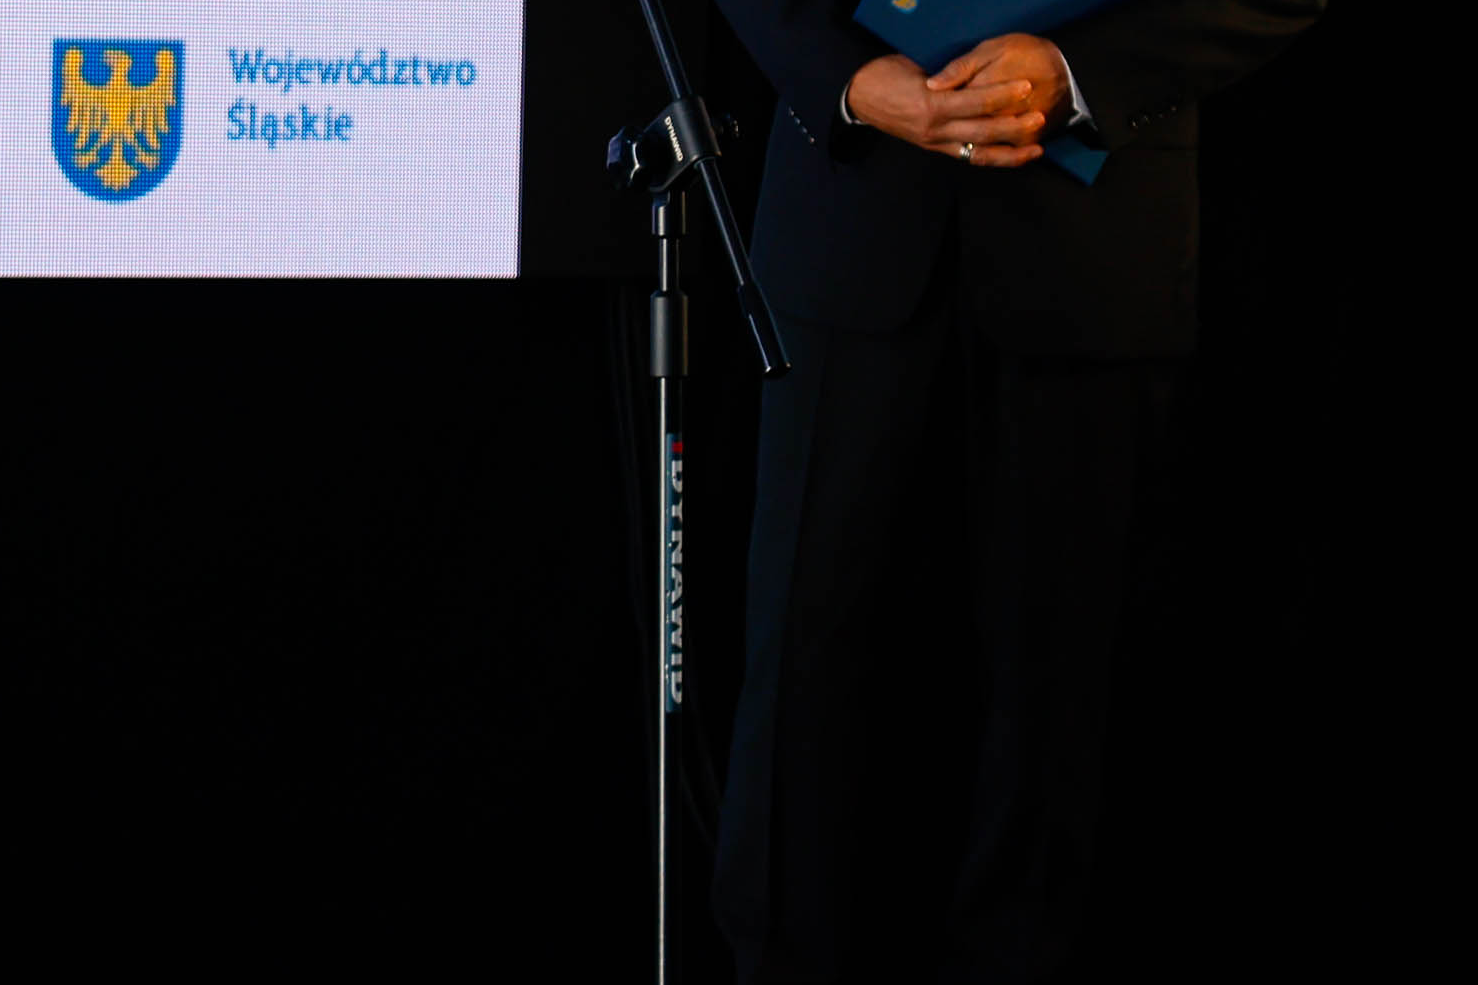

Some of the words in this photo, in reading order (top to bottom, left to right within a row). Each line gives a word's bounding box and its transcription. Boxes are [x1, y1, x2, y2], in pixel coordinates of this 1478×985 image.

[228, 48, 478, 93] Województwo
[227, 97, 354, 150] Śląskie
[664, 115, 683, 162] DYNAWID
[672, 460, 683, 704] DYNAWID
